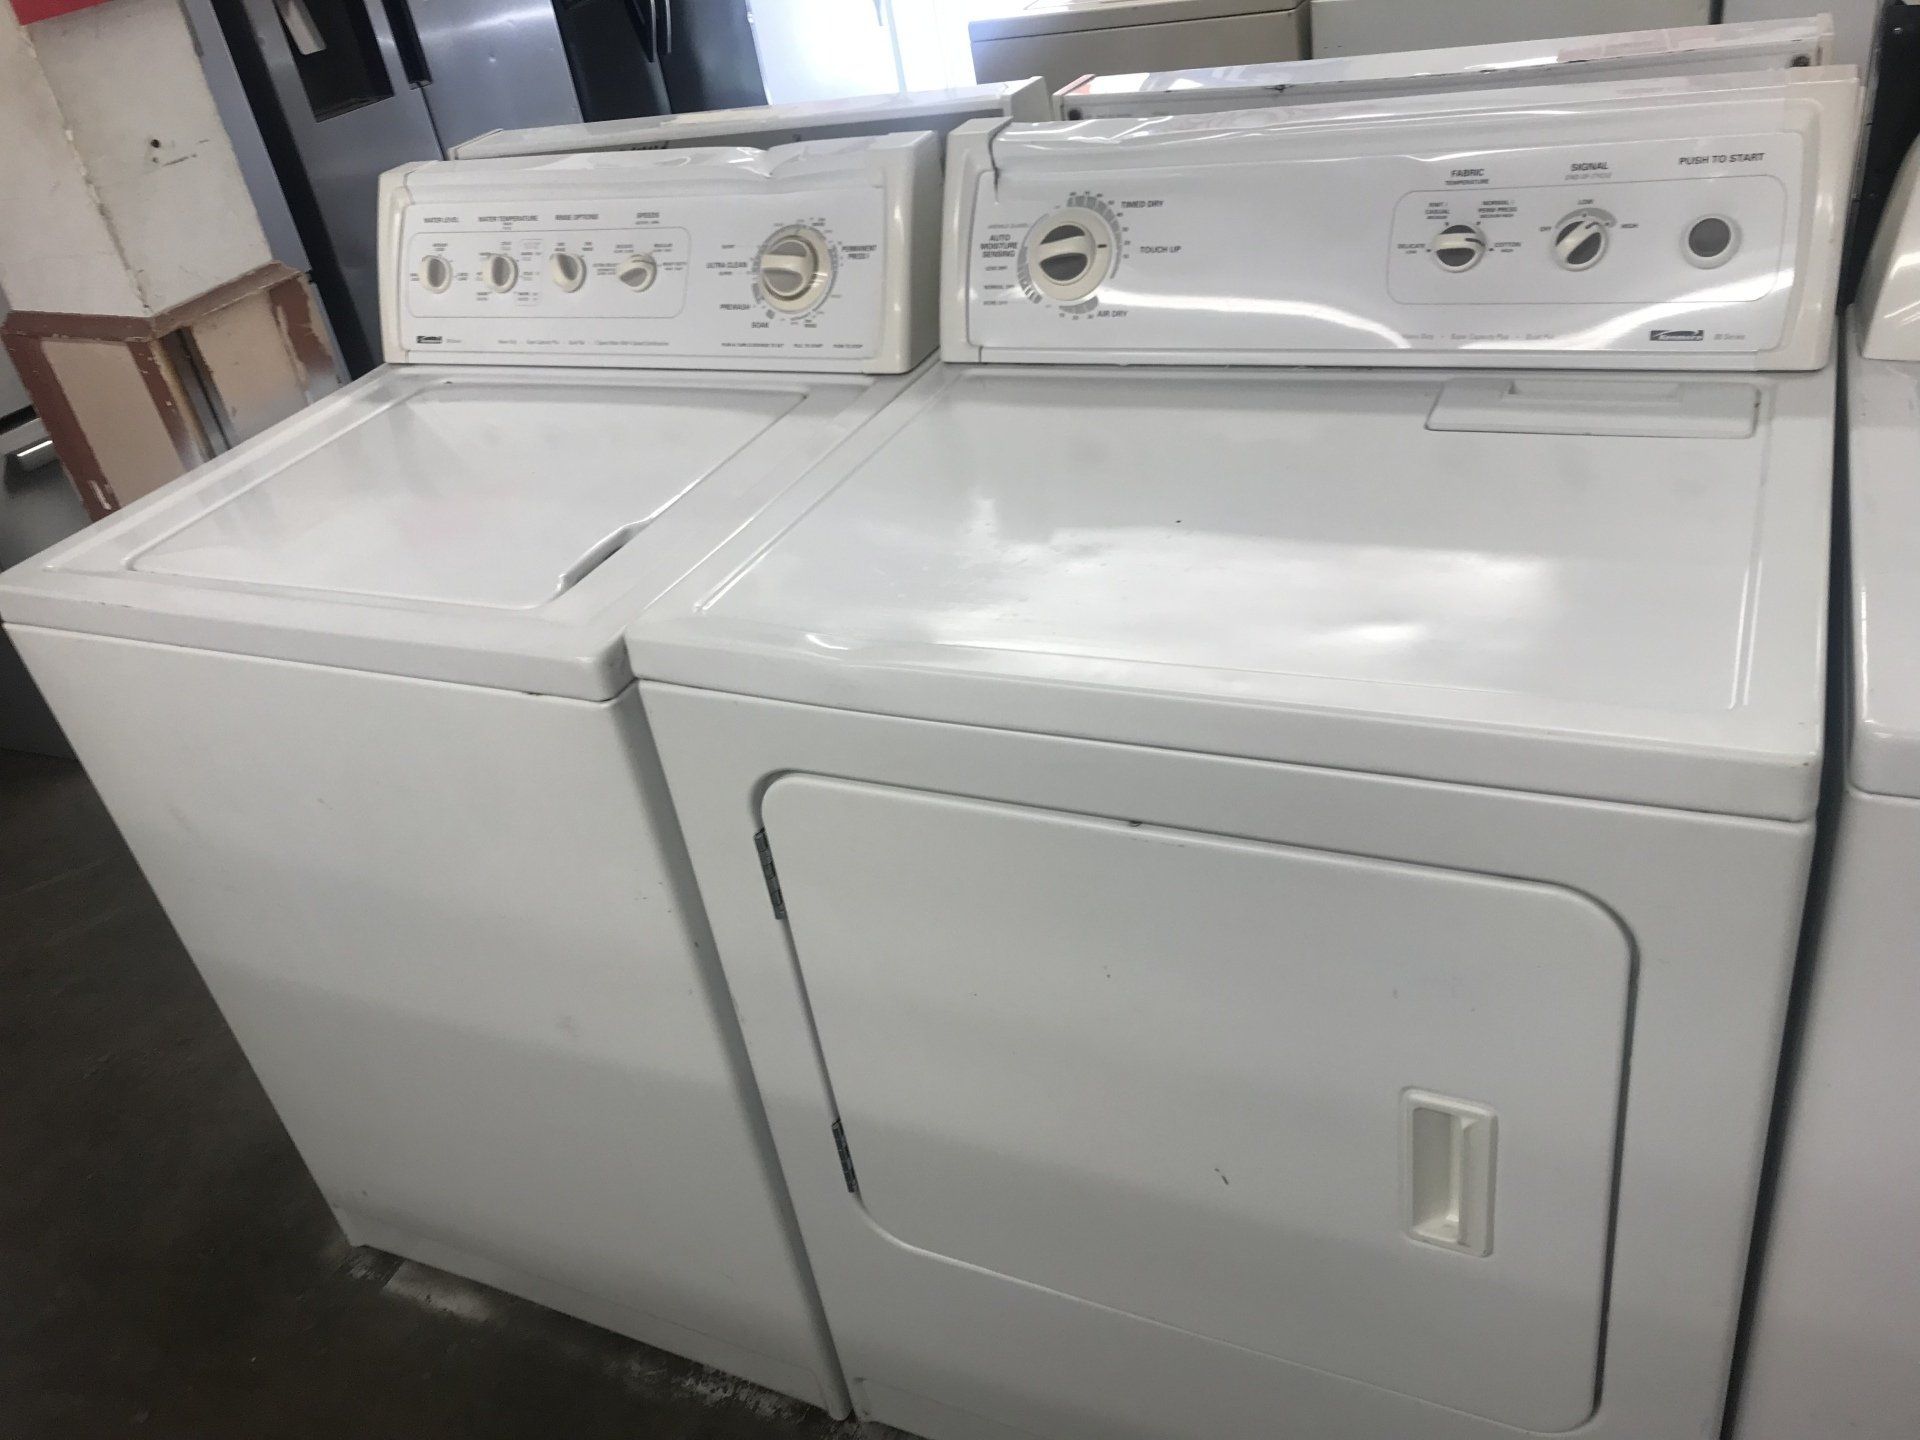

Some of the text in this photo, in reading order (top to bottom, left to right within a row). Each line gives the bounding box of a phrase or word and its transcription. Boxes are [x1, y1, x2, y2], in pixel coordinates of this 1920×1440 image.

[1678, 152, 1765, 166] PUSH TO START
[1571, 162, 1608, 171] SIGNAL
[1451, 168, 1485, 177] FABRIC
[1121, 200, 1164, 209] TIMED DRY
[980, 242, 1017, 250] MOISTURE
[1170, 245, 1181, 253] UP
[982, 250, 1016, 258] SENSING
[1097, 310, 1128, 318] AIR DRY
